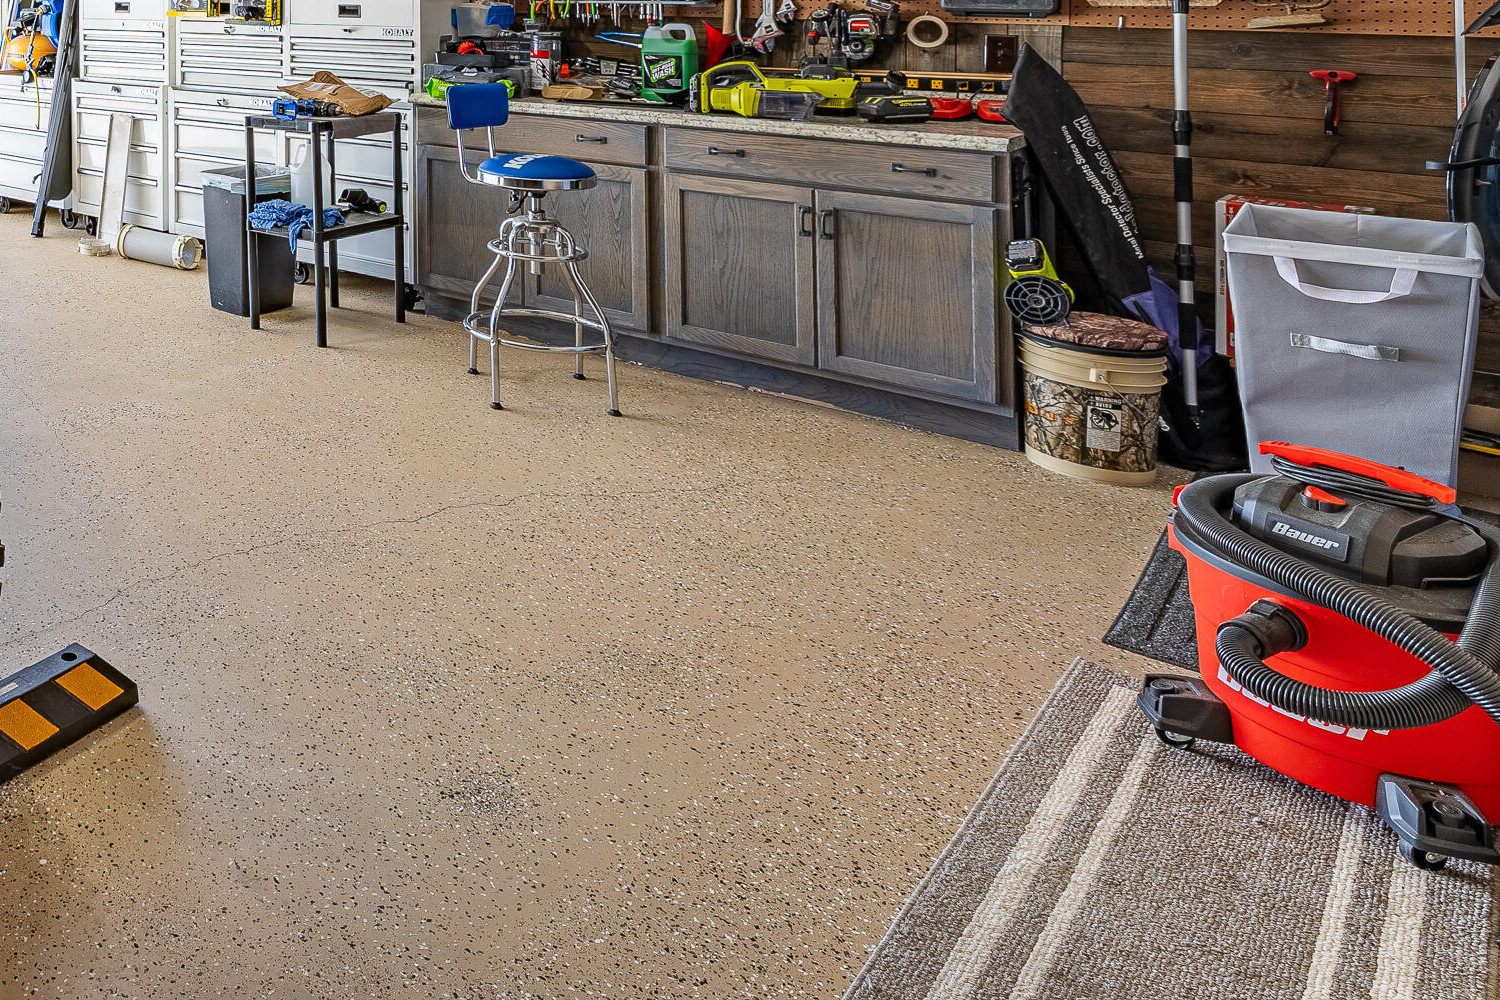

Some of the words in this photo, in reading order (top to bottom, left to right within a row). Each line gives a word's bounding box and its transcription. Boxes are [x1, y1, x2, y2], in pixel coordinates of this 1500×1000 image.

[381, 28, 414, 37] KOBALT
[652, 65, 675, 80] WASH
[1070, 143, 1086, 165] Since
[1081, 164, 1113, 205] Specialists
[1108, 205, 1132, 238] Detector
[1127, 237, 1145, 260] Metal
[1272, 521, 1340, 549] Bauer
